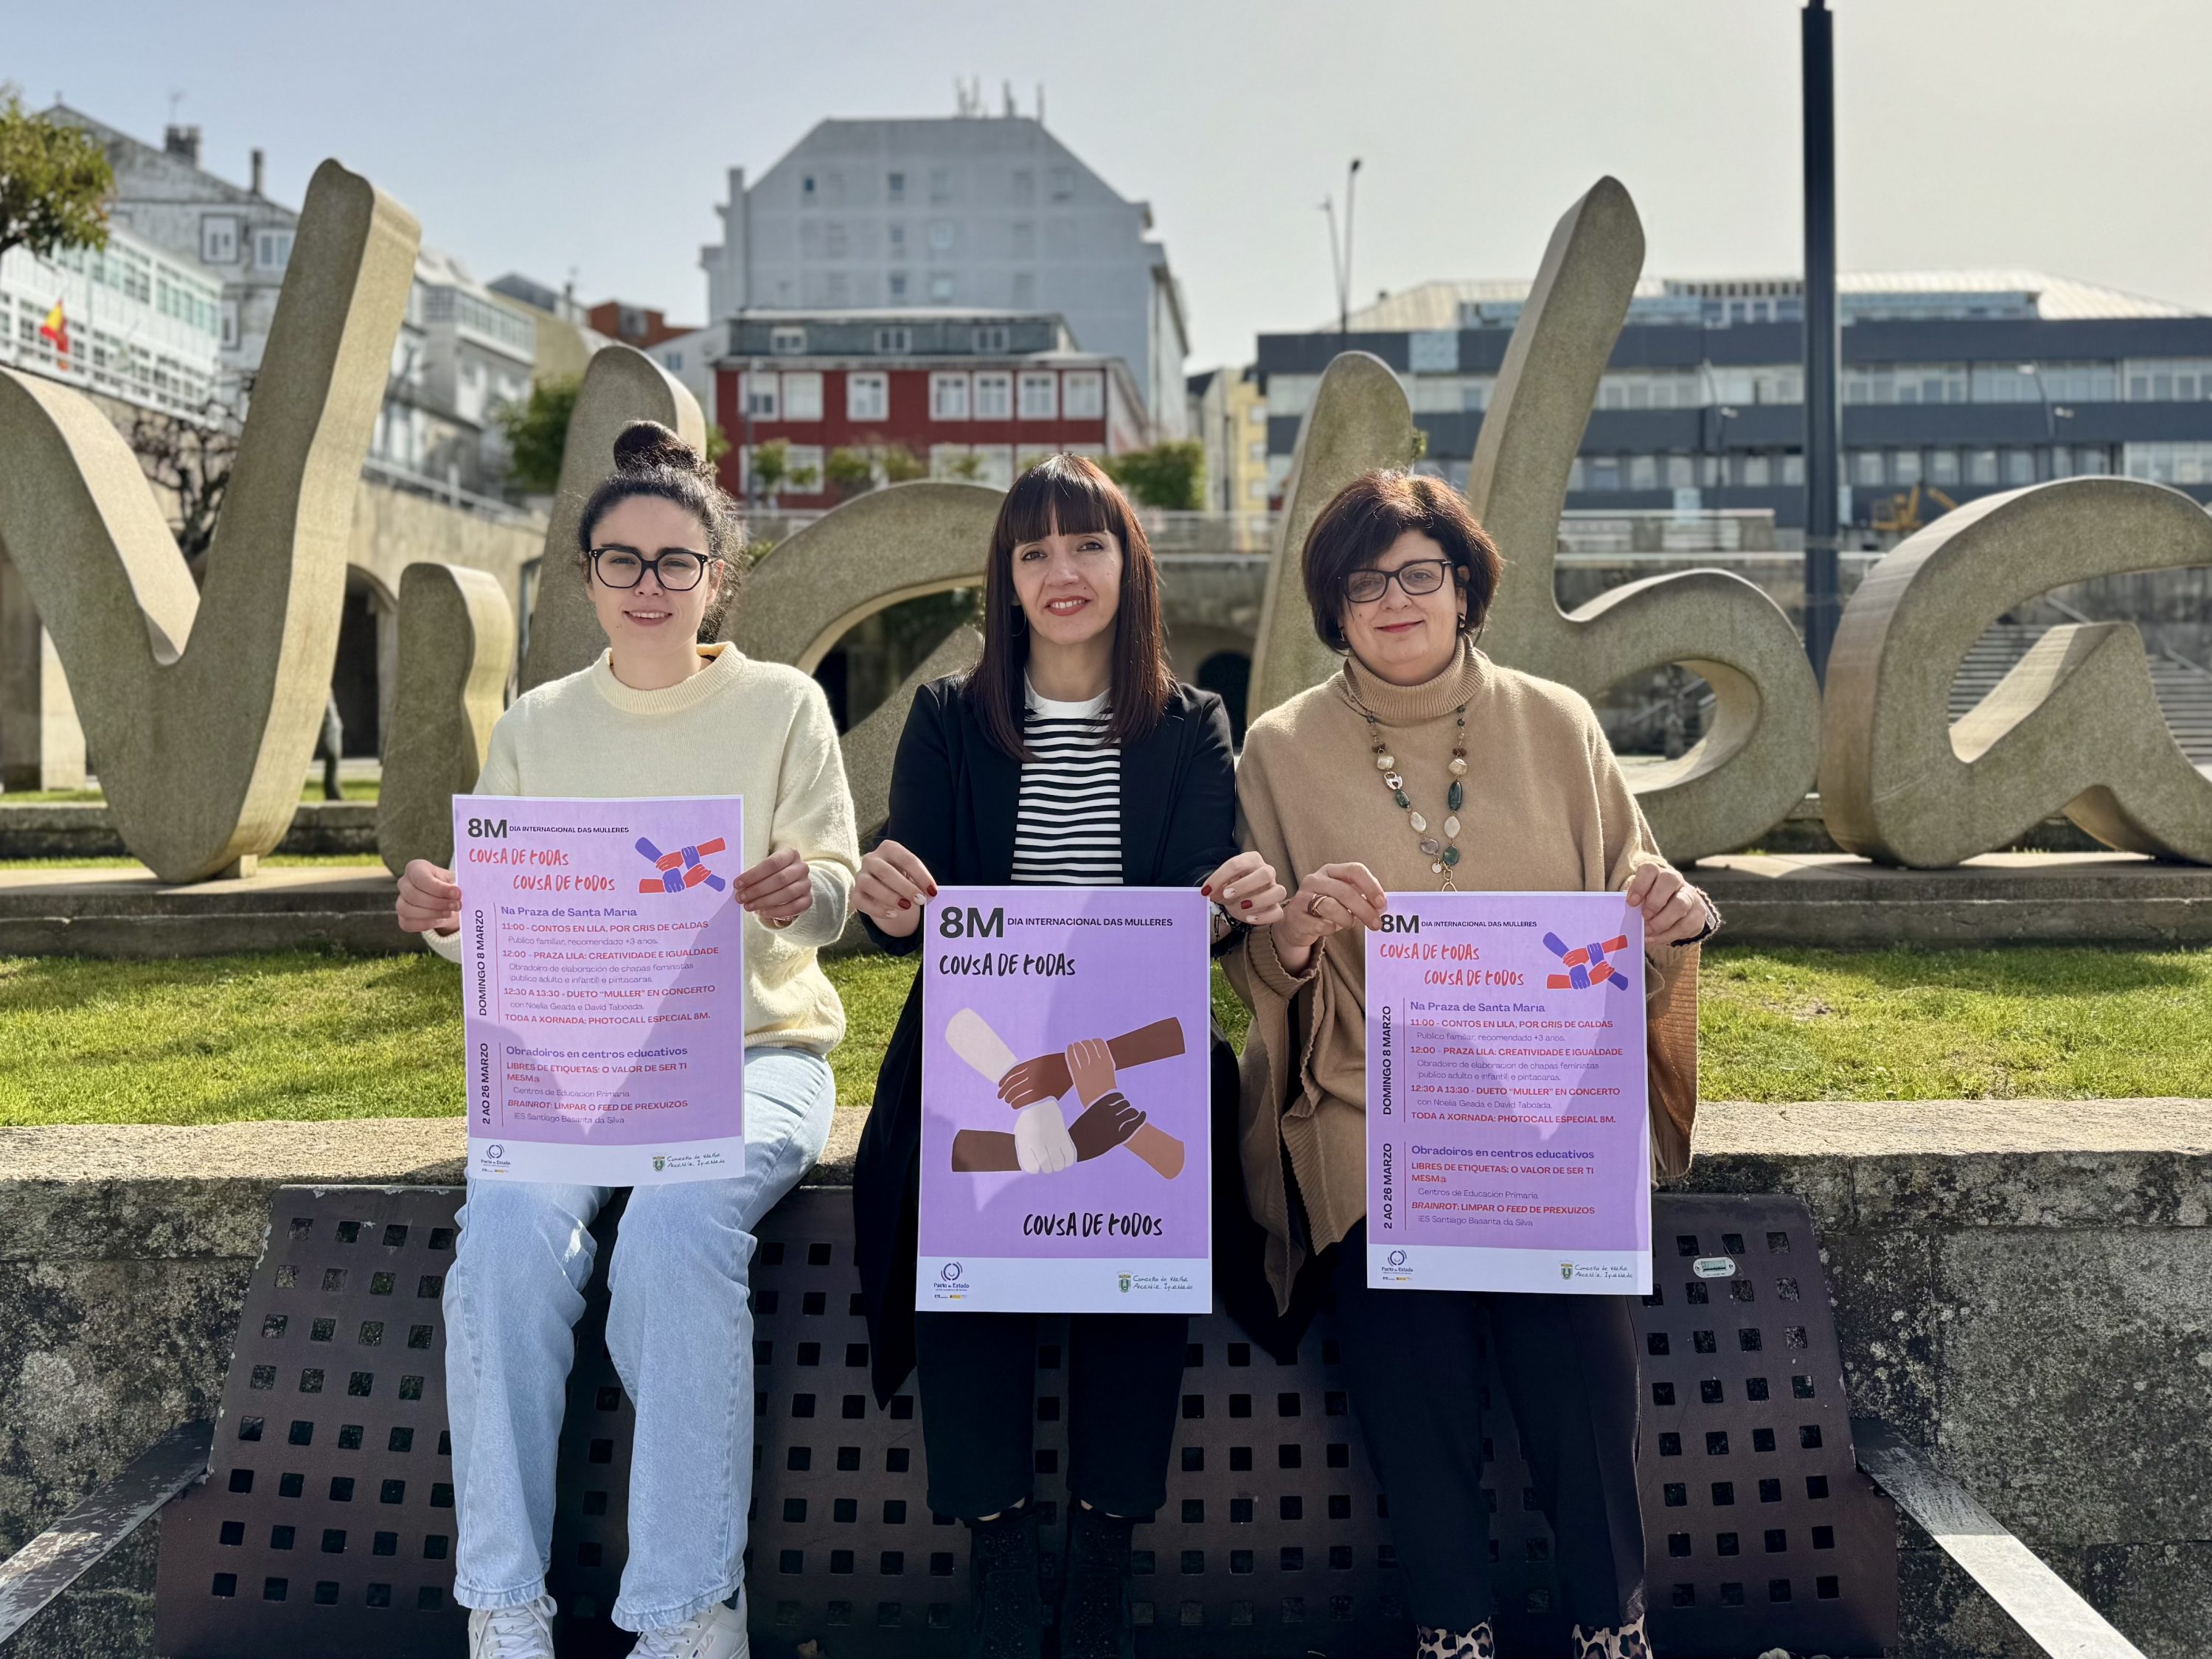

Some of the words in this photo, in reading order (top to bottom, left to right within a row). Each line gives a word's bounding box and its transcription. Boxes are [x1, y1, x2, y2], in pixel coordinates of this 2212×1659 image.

[467, 818, 507, 838] 8M
[512, 848, 526, 865] DE
[556, 874, 571, 891] DE
[501, 906, 515, 915] Na
[518, 908, 549, 917] Praza
[552, 908, 565, 917] de
[568, 908, 601, 917] Santa
[475, 910, 484, 950] MARZO
[633, 924, 655, 932] CRIS
[671, 921, 709, 931] CALDAS
[939, 906, 1004, 939] 8M
[1026, 917, 1102, 926] INTERNACIONAL
[1103, 918, 1123, 926] DAS
[1124, 918, 1173, 926] MULLERES
[1380, 914, 1419, 933] 8M
[502, 950, 526, 958] 12:00
[533, 951, 563, 959] PRAZA
[666, 947, 719, 958] IGUALDADE
[1422, 944, 1438, 961] DE
[998, 953, 1019, 977] DE
[1467, 970, 1482, 987] DE
[477, 961, 487, 1016] DOMINGO
[1411, 1001, 1425, 1010] Na
[1427, 1002, 1460, 1011] Praza
[1462, 1003, 1476, 1012] de
[1478, 1003, 1510, 1012] Santa
[1382, 1006, 1391, 1048] MARZO
[1441, 1020, 1481, 1028] CONTOS
[1497, 1020, 1517, 1029] LILA,
[506, 1046, 565, 1057] Obradoiros
[567, 1050, 580, 1058] en
[582, 1048, 625, 1059] centros
[627, 1047, 688, 1058] educativos
[1443, 1047, 1474, 1055] PRAZA
[1476, 1048, 1497, 1056] LILA:
[480, 1043, 489, 1083] MARZO
[481, 1085, 490, 1099] 26
[1382, 1058, 1391, 1115] DOMINGO
[1411, 1085, 1435, 1093] 12:30
[1445, 1086, 1470, 1094] 13:30
[1476, 1087, 1508, 1095] DUETO
[1568, 1088, 1621, 1096] CONCERTO
[482, 1100, 490, 1116] AO
[1447, 1113, 1496, 1122] XORNADA:
[1498, 1115, 1554, 1124] PHOTOCALL
[1555, 1116, 1598, 1124] ESPECIAL
[1411, 1146, 1473, 1156] Obradoiros
[1490, 1150, 1534, 1158] centros
[1536, 1150, 1594, 1159] educativos
[1383, 1144, 1392, 1185] MARZO
[1411, 1162, 1442, 1170] LIBRES
[1458, 1164, 1509, 1173] ETIQUETAS:
[1384, 1187, 1392, 1202] 26
[1418, 1188, 1450, 1196] Centros
[1505, 1192, 1538, 1200] Primaria
[1383, 1206, 1393, 1220] AO
[1412, 1202, 1460, 1211] BRAINROT:
[1461, 1204, 1495, 1212] LIMPAR
[1506, 1205, 1528, 1213] FEED
[1543, 1206, 1596, 1214] PREXUIZOS
[1082, 1212, 1104, 1237] DE
[1432, 1216, 1467, 1225] Santiago
[1468, 1217, 1501, 1225] Basanta
[1515, 1219, 1533, 1227] Silva
